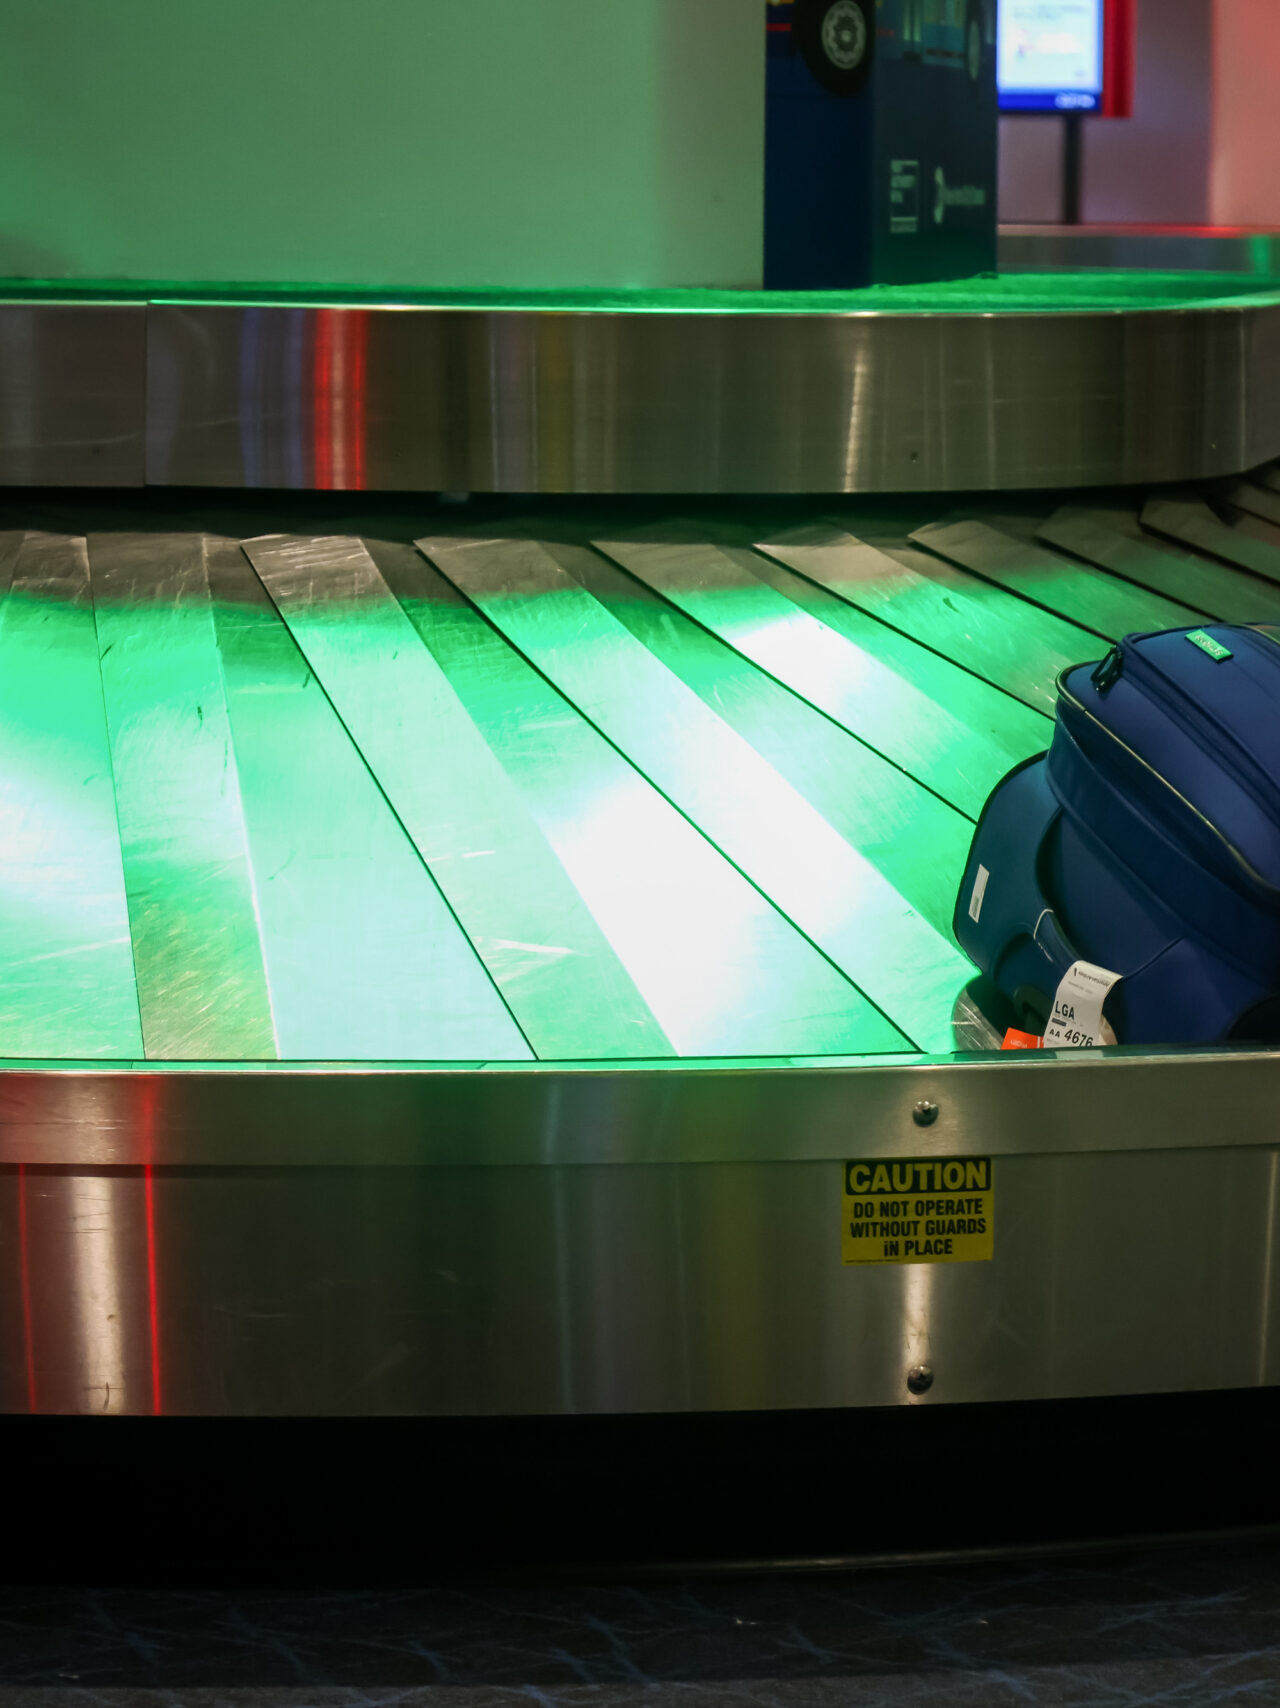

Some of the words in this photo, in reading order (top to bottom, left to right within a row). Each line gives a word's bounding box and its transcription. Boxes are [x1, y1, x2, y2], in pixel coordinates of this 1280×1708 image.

[1055, 1001, 1075, 1020] LGA
[1049, 1028, 1060, 1038] AA
[1064, 1029, 1094, 1047] 4676
[850, 1161, 986, 1193] CAUTION
[854, 1202, 874, 1218] DO
[880, 1201, 909, 1218] NOT
[915, 1198, 983, 1217] OPERATE
[850, 1220, 920, 1238] WITHOUT
[925, 1218, 986, 1236] GUARDS
[905, 1238, 953, 1256] PLACE
